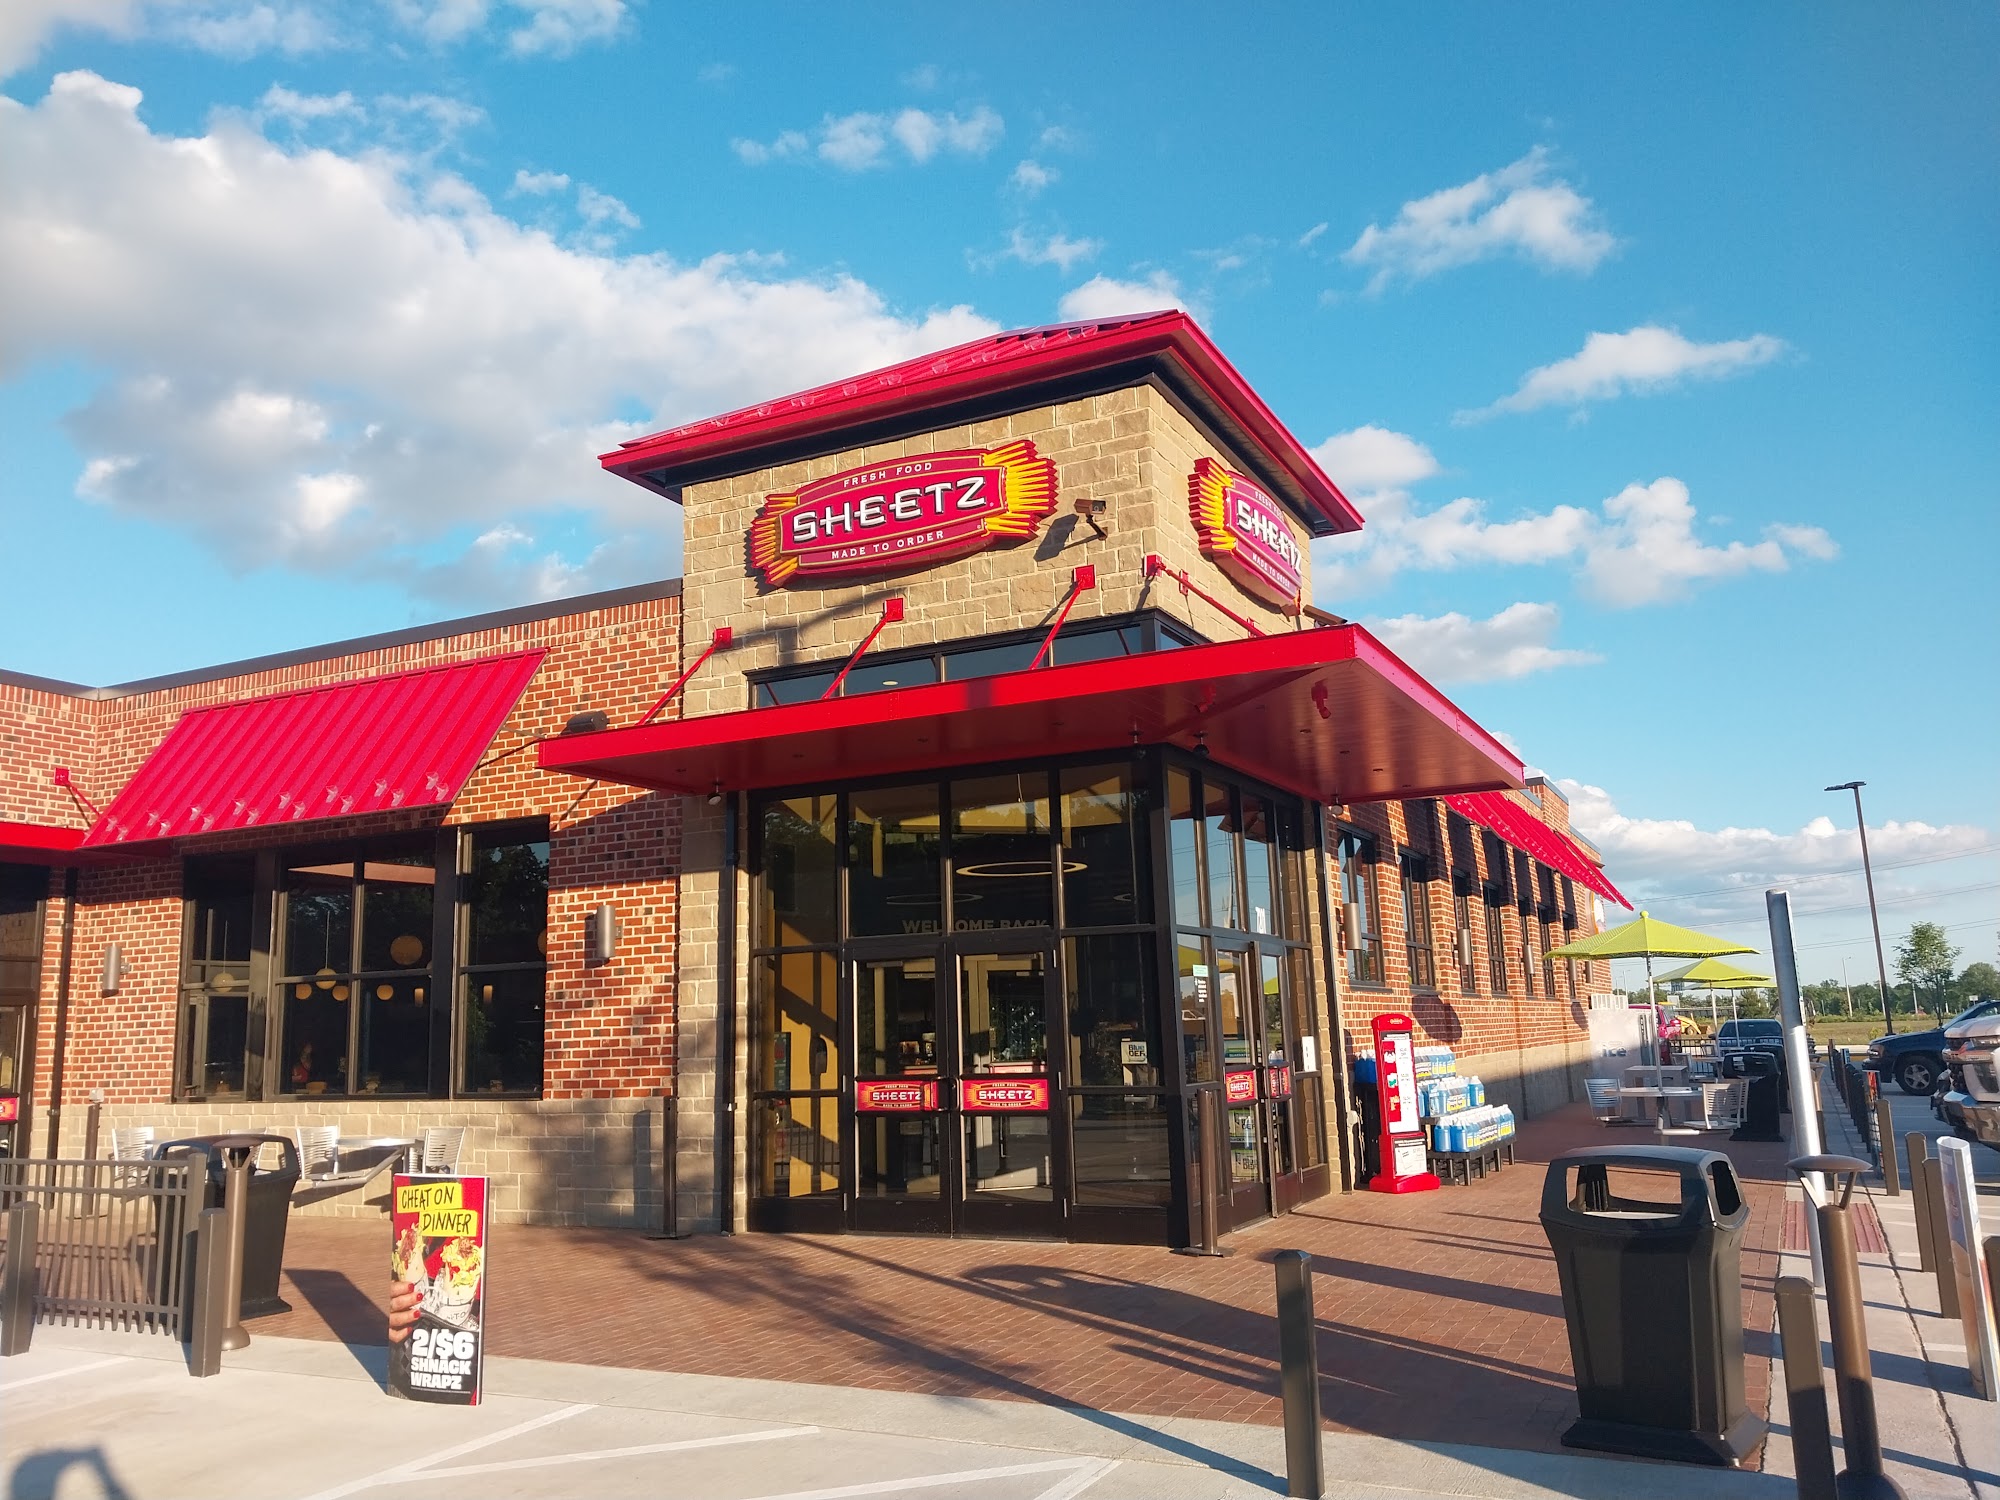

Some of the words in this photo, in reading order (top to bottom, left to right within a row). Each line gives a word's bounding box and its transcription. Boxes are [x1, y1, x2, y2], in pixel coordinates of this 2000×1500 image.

[843, 471, 886, 488] FRESH
[896, 462, 933, 476] FOOD
[792, 475, 988, 544] SHEETZ
[831, 546, 866, 560] MADE
[873, 542, 890, 553] TO
[896, 530, 944, 547] ORDER
[1252, 552, 1268, 572] MADE
[1269, 565, 1276, 577] TO
[902, 919, 994, 934] WELOME
[872, 1091, 922, 1101] SHEETZ
[978, 1090, 1033, 1100] SHEETZ
[1230, 1081, 1250, 1092] SHEETZ
[401, 1187, 432, 1210] CHEAT
[434, 1186, 455, 1205] ON
[422, 1211, 472, 1234] DINNER
[411, 1328, 475, 1360] 2/$6
[410, 1356, 472, 1375] SHNACK
[410, 1371, 463, 1390] WRAPZ
